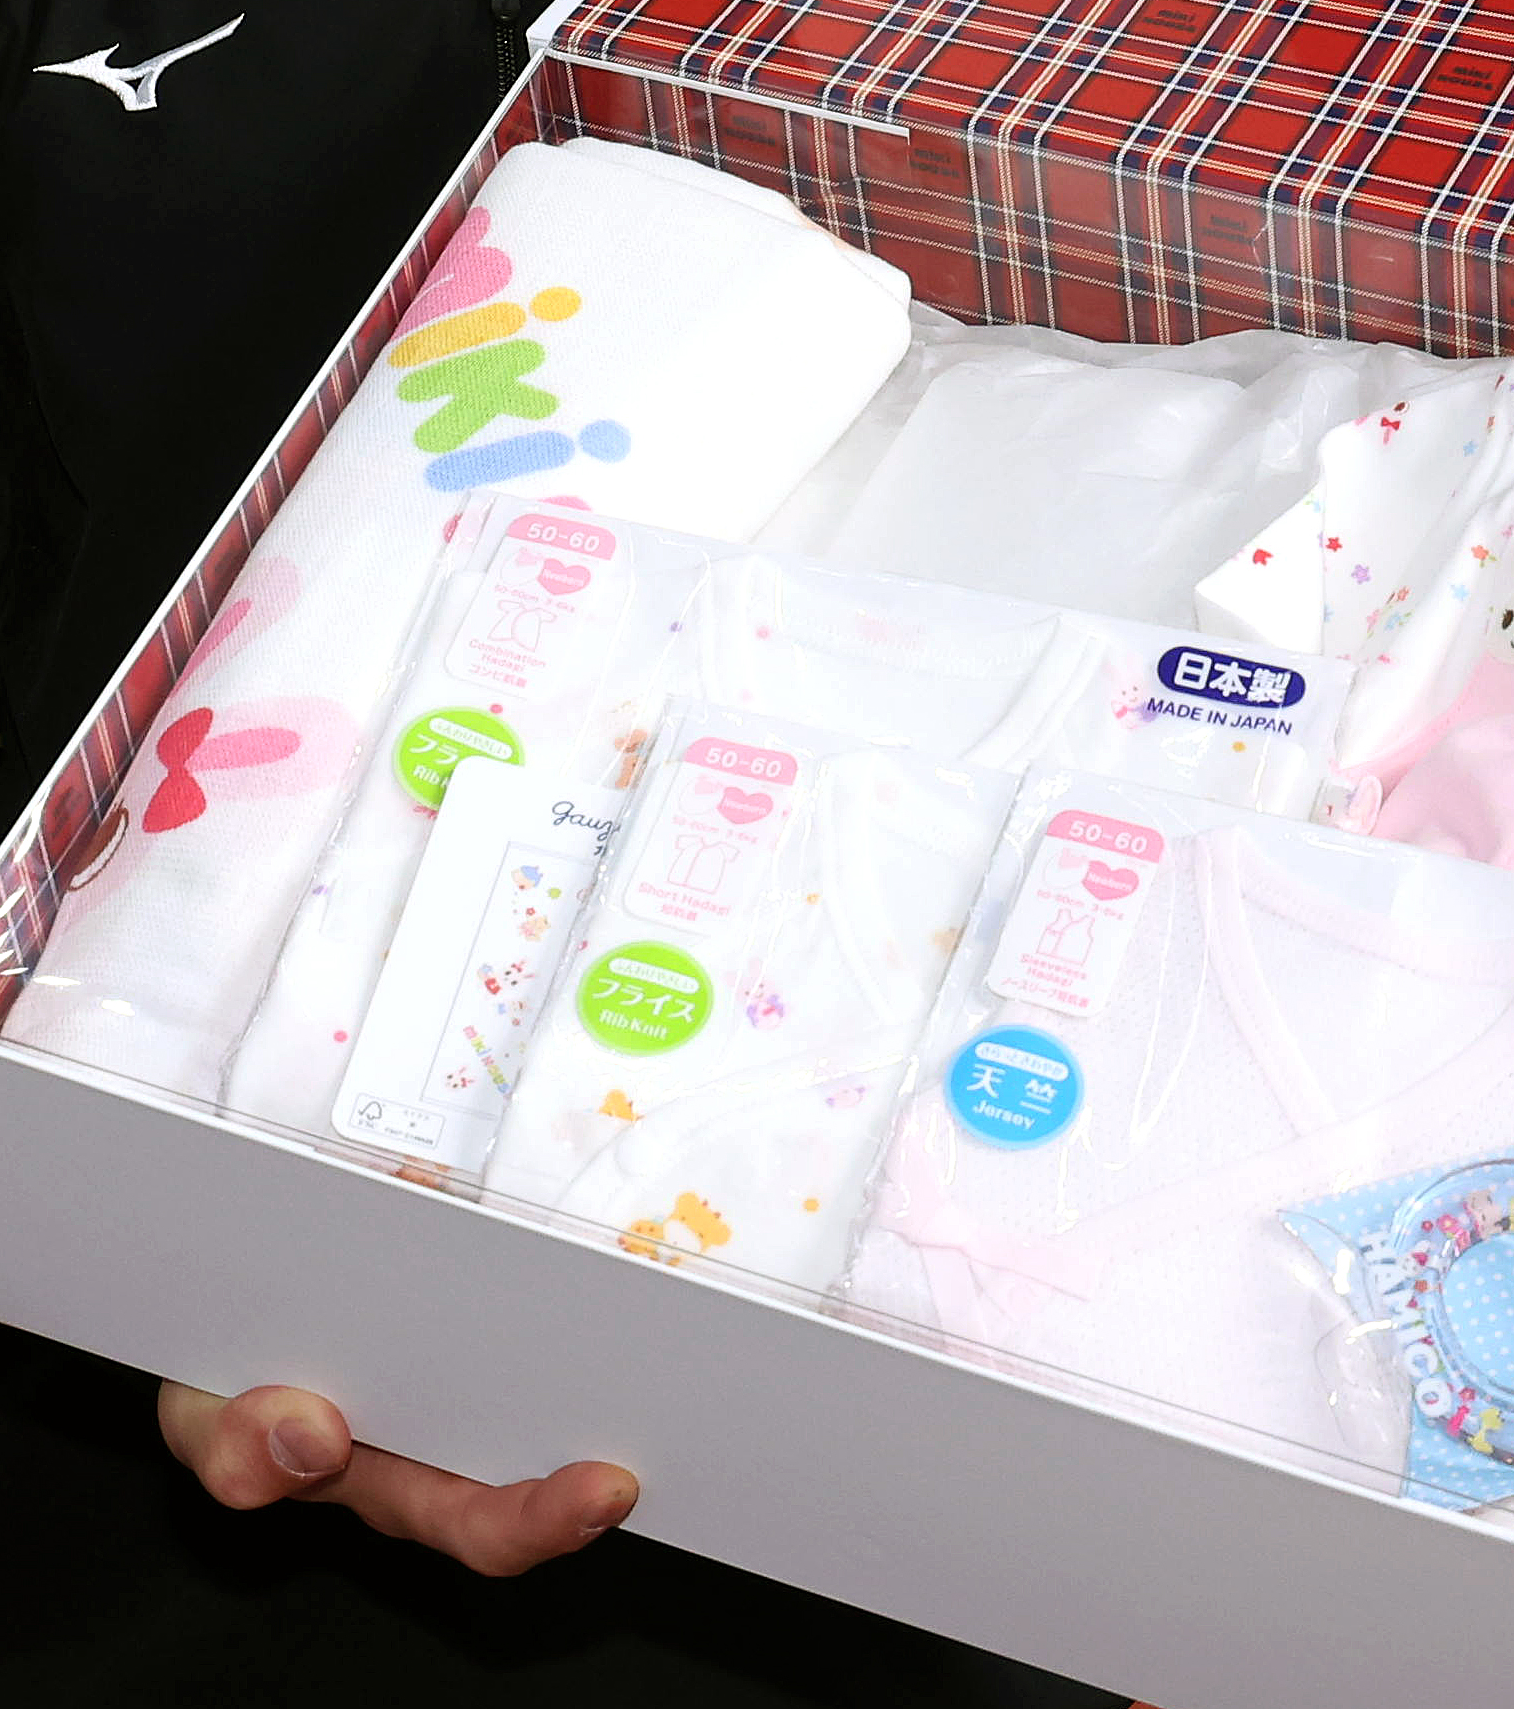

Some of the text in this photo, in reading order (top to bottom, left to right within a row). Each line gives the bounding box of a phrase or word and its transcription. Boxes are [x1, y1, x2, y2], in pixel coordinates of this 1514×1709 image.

[527, 522, 600, 553] 50-60
[469, 638, 546, 667] Combination
[1174, 651, 1292, 704] 日本製
[1147, 698, 1292, 736] MADE IN JAPAN
[704, 747, 782, 778] 50-60
[1068, 819, 1148, 854] 50-60
[591, 978, 696, 1023] フライス
[598, 1008, 668, 1040] Rib Knit
